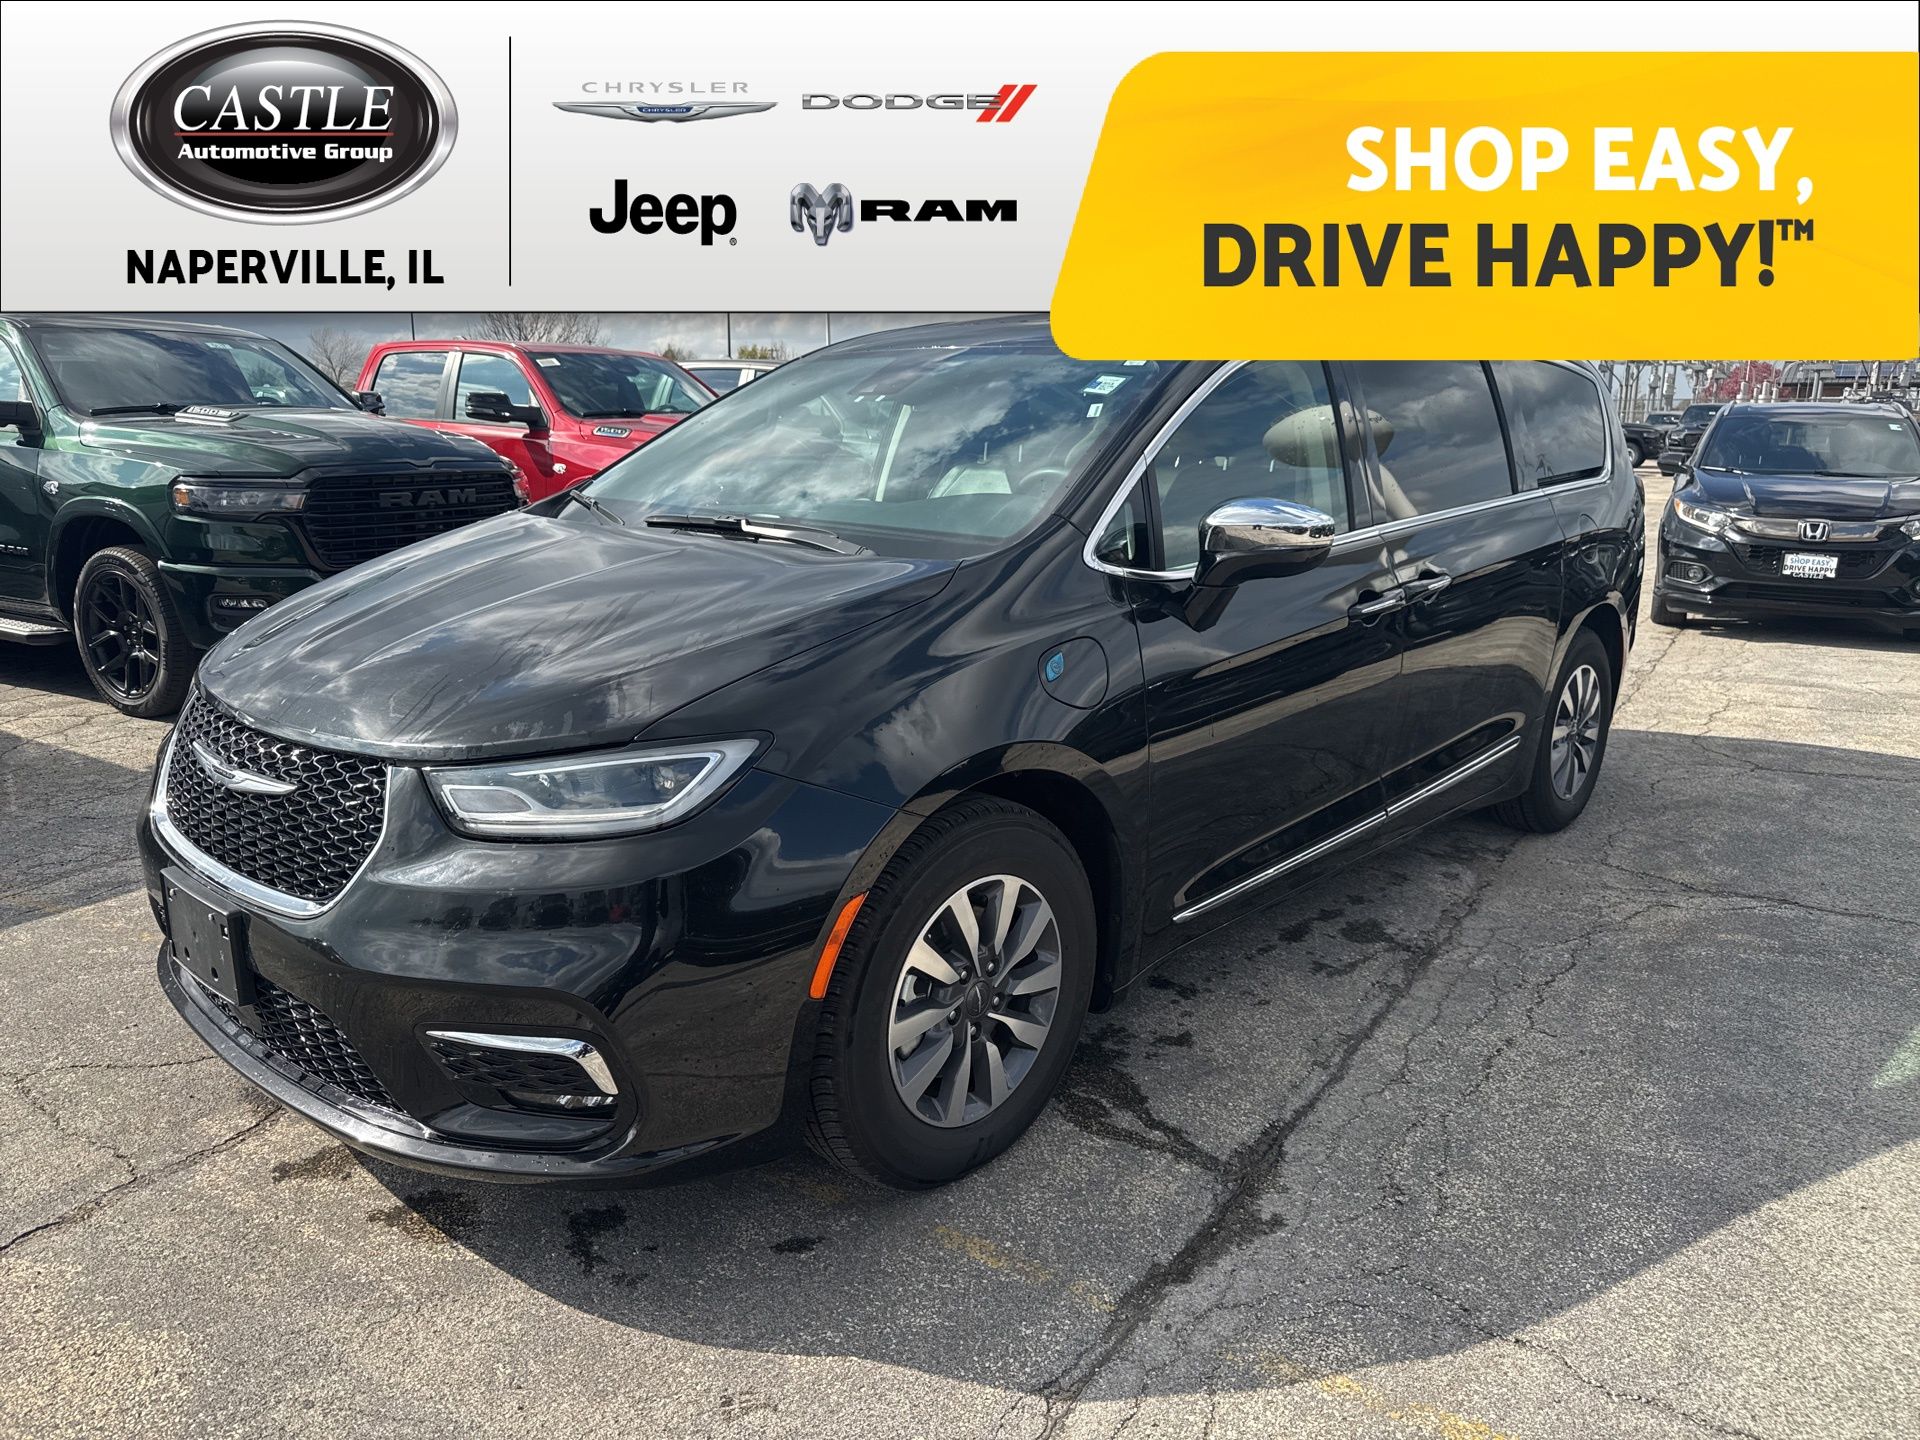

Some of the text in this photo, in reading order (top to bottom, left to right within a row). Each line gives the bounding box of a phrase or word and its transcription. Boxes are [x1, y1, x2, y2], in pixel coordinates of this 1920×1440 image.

[379, 488, 477, 508] RAM
[1790, 557, 1811, 565] SHOP
[1783, 564, 1807, 572] DRIVE
